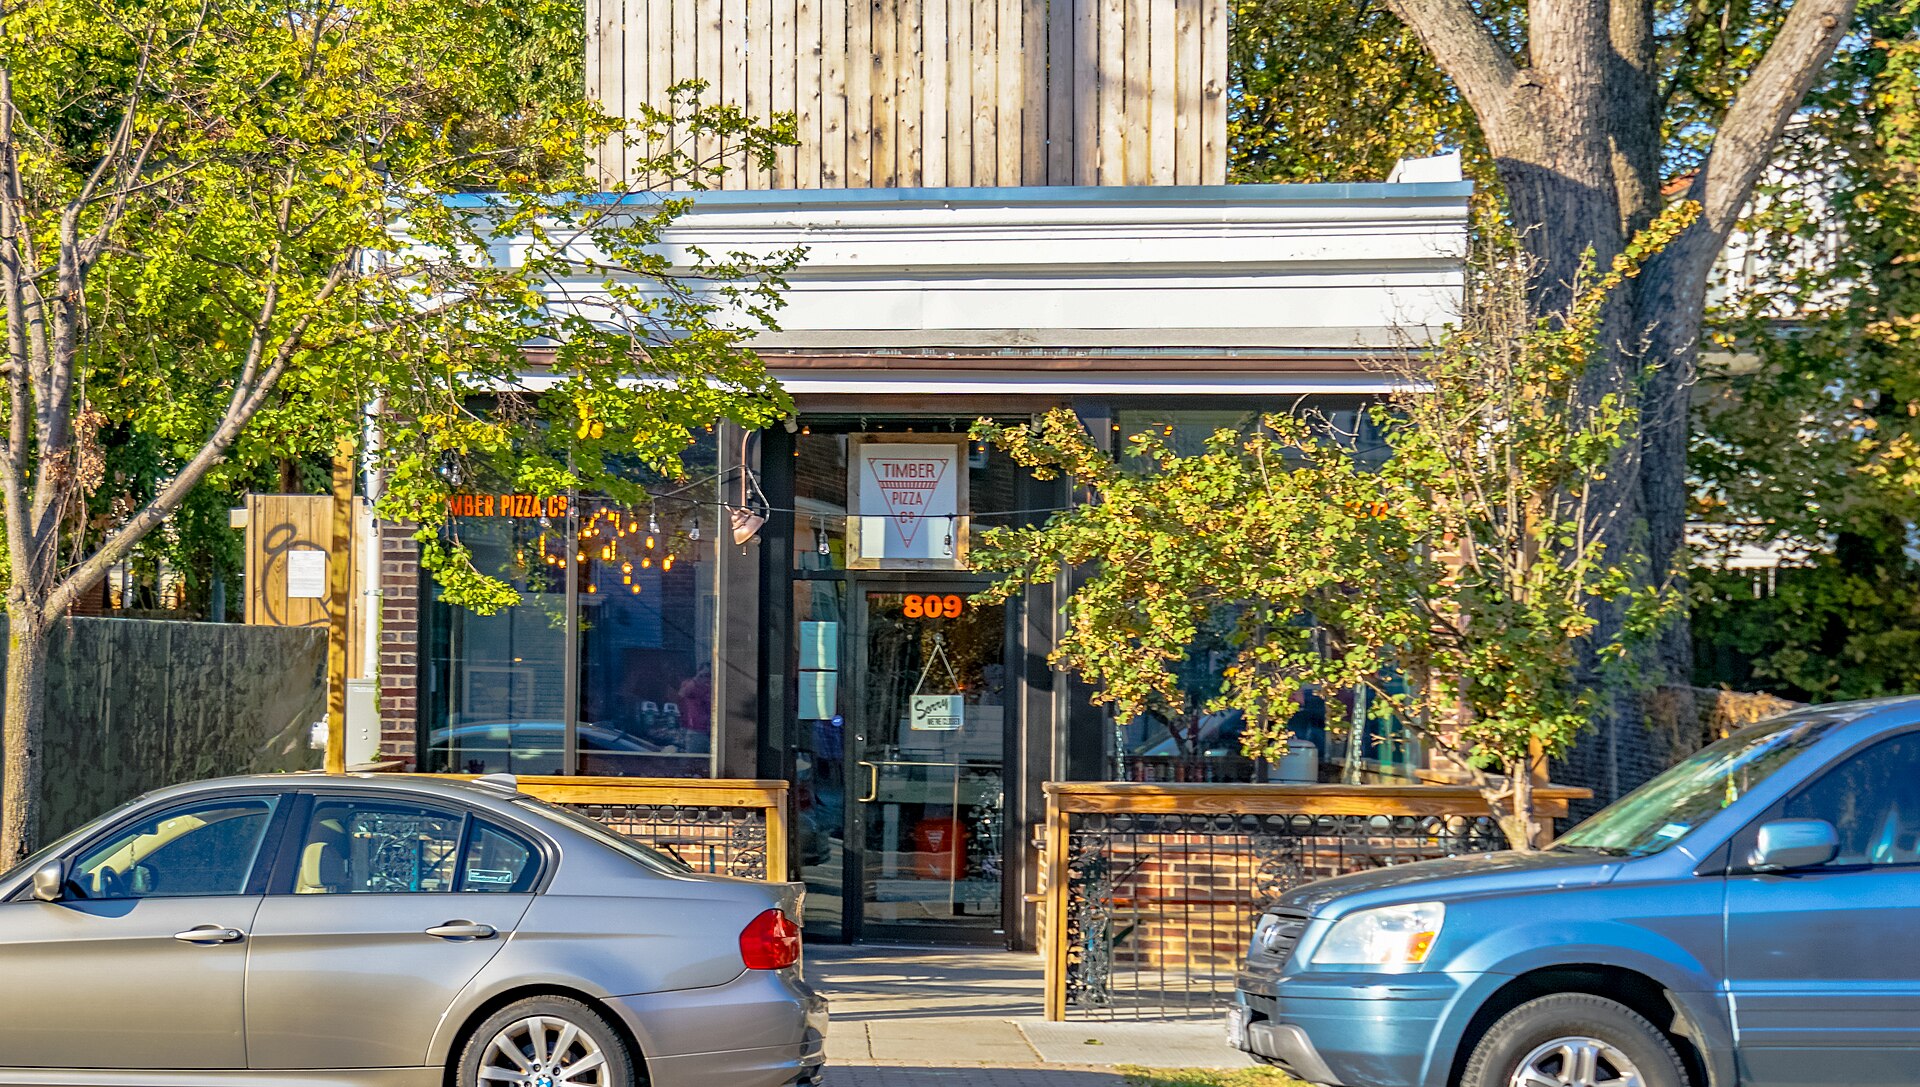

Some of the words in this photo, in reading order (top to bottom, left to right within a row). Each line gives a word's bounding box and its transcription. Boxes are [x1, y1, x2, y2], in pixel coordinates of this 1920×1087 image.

[882, 463, 935, 478] TIMBER
[450, 495, 494, 517] MBER
[500, 494, 542, 517] PIZZA
[892, 491, 923, 505] PIZZA
[903, 594, 963, 618] 809
[914, 698, 949, 720] Sorry
